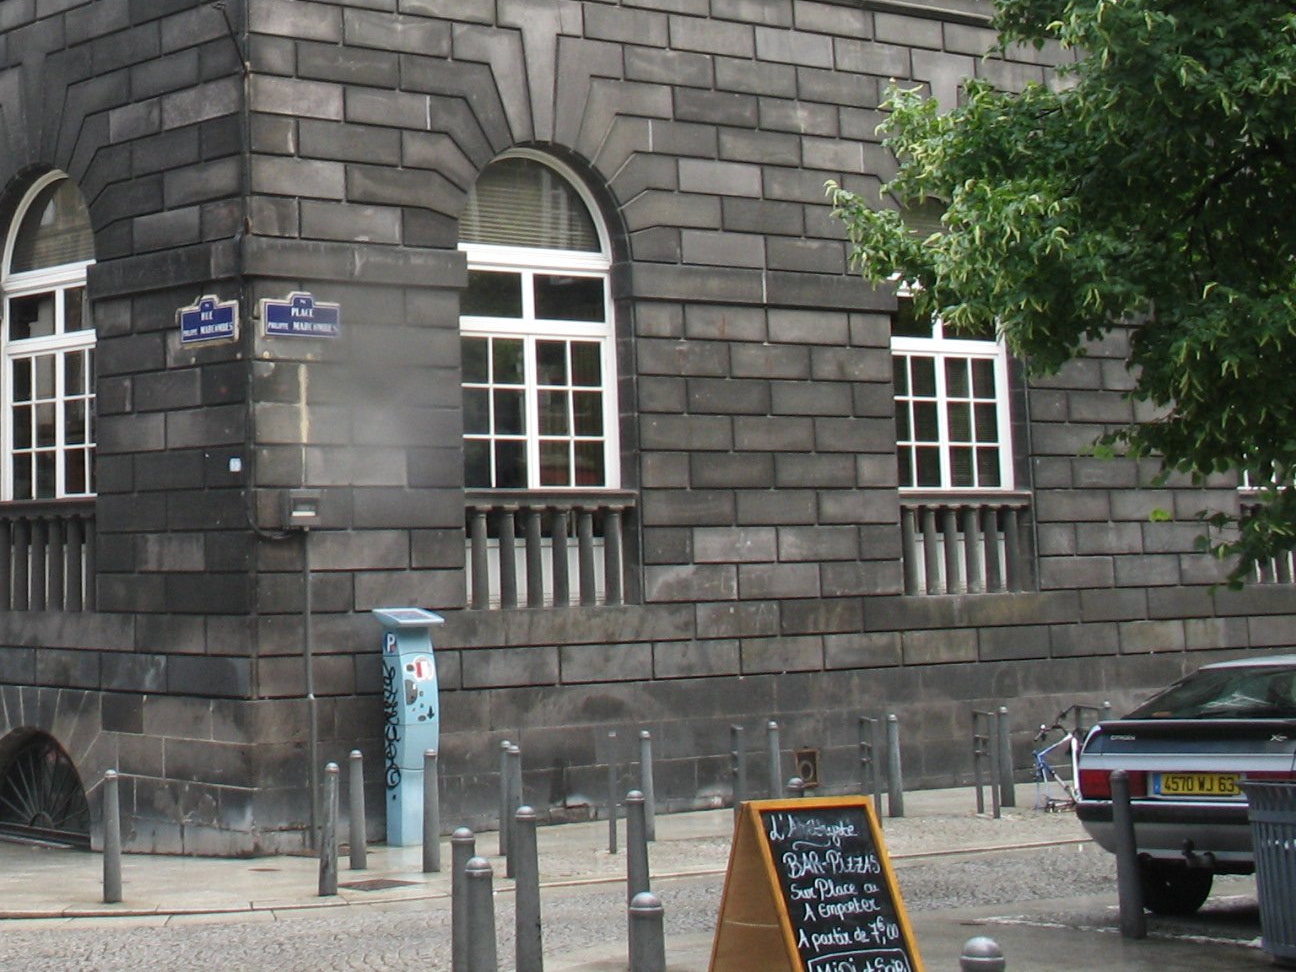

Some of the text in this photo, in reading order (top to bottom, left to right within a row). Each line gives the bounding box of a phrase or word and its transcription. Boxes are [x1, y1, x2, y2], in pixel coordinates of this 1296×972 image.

[200, 310, 213, 321] RUE
[291, 307, 314, 318] PLACE
[386, 633, 396, 653] P
[1163, 777, 1235, 793] 4570 WJ 63
[790, 878, 880, 901] Sur Place ou
[810, 927, 853, 952] partir
[853, 926, 870, 943] de
